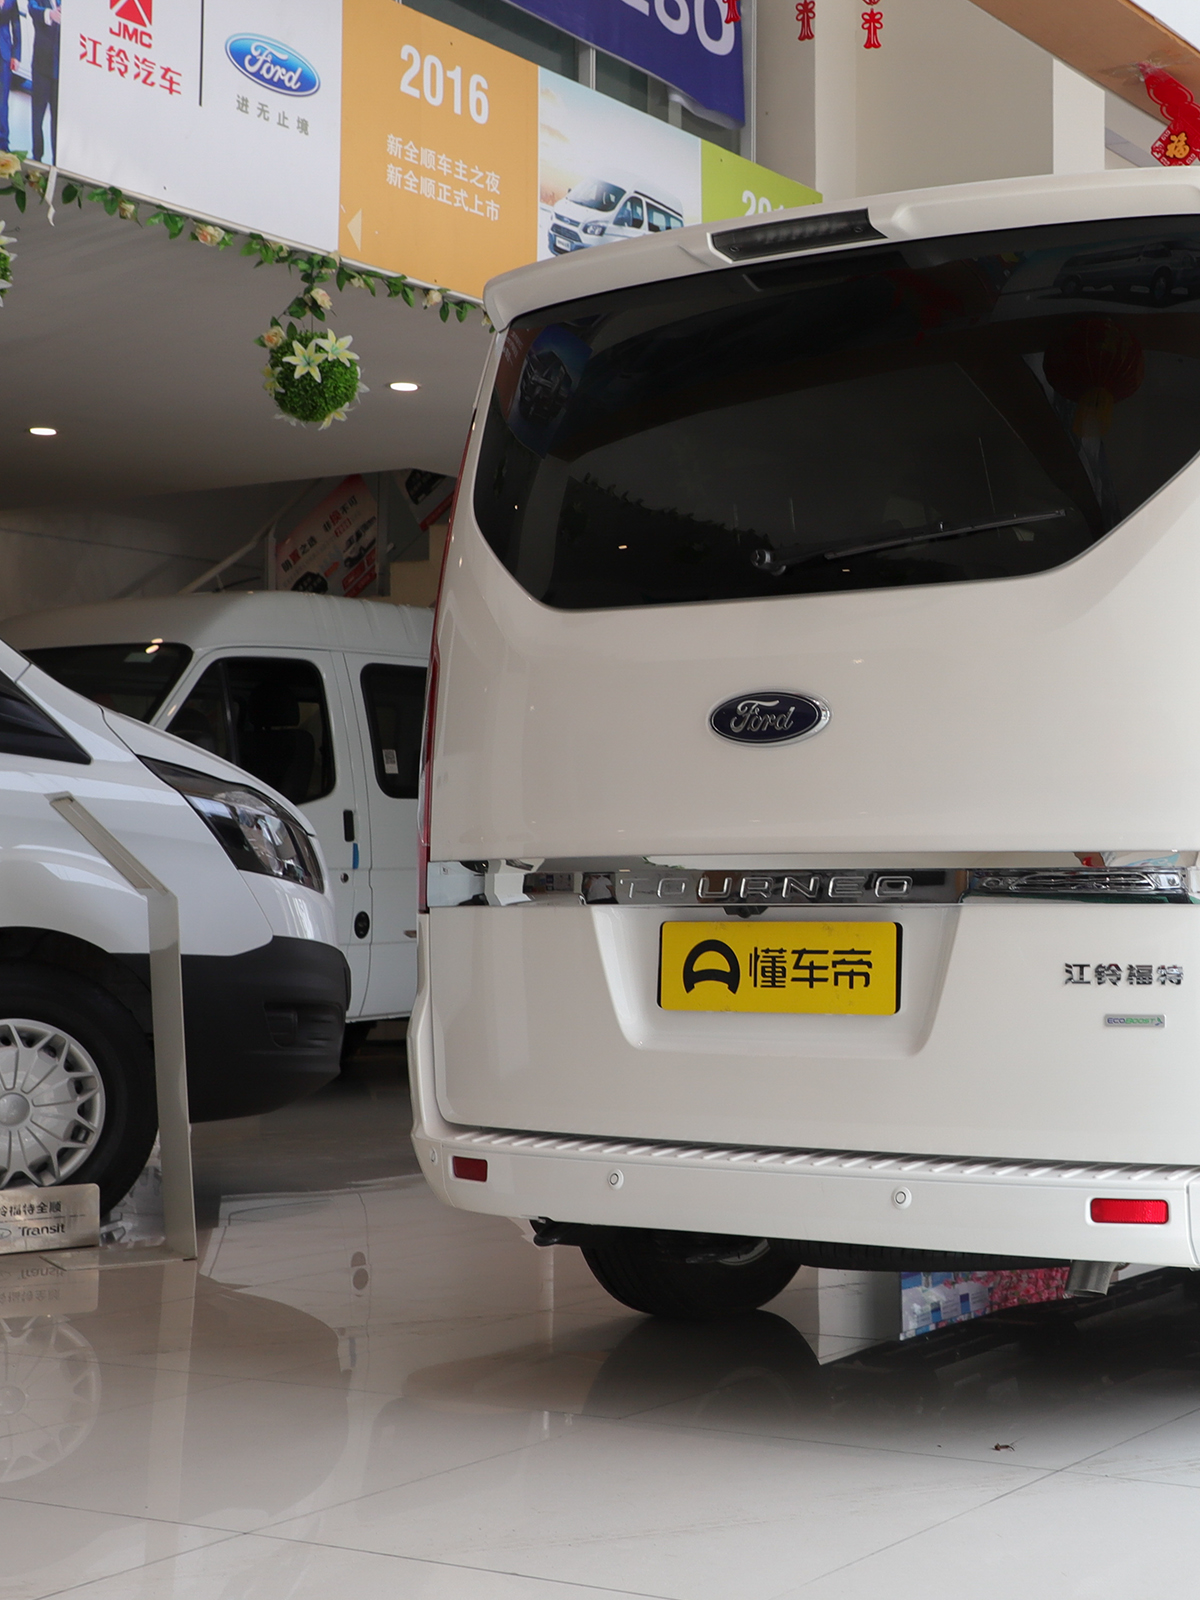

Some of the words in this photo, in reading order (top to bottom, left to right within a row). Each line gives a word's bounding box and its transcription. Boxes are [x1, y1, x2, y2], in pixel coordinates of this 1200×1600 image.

[109, 21, 153, 49] JMC
[79, 33, 182, 95] 江铃汽车
[244, 42, 301, 90] Ford
[400, 44, 489, 125] 2016
[236, 94, 309, 136] 进无止境
[386, 133, 500, 195] 新全顺车主之夜
[386, 163, 500, 221] 新全顺正式上市
[729, 700, 796, 733] Ford
[620, 876, 914, 899] TOURNEO
[749, 946, 873, 990] 懂车帝
[1064, 963, 1184, 987] 江铃福特
[18, 1223, 66, 1237] Transit
